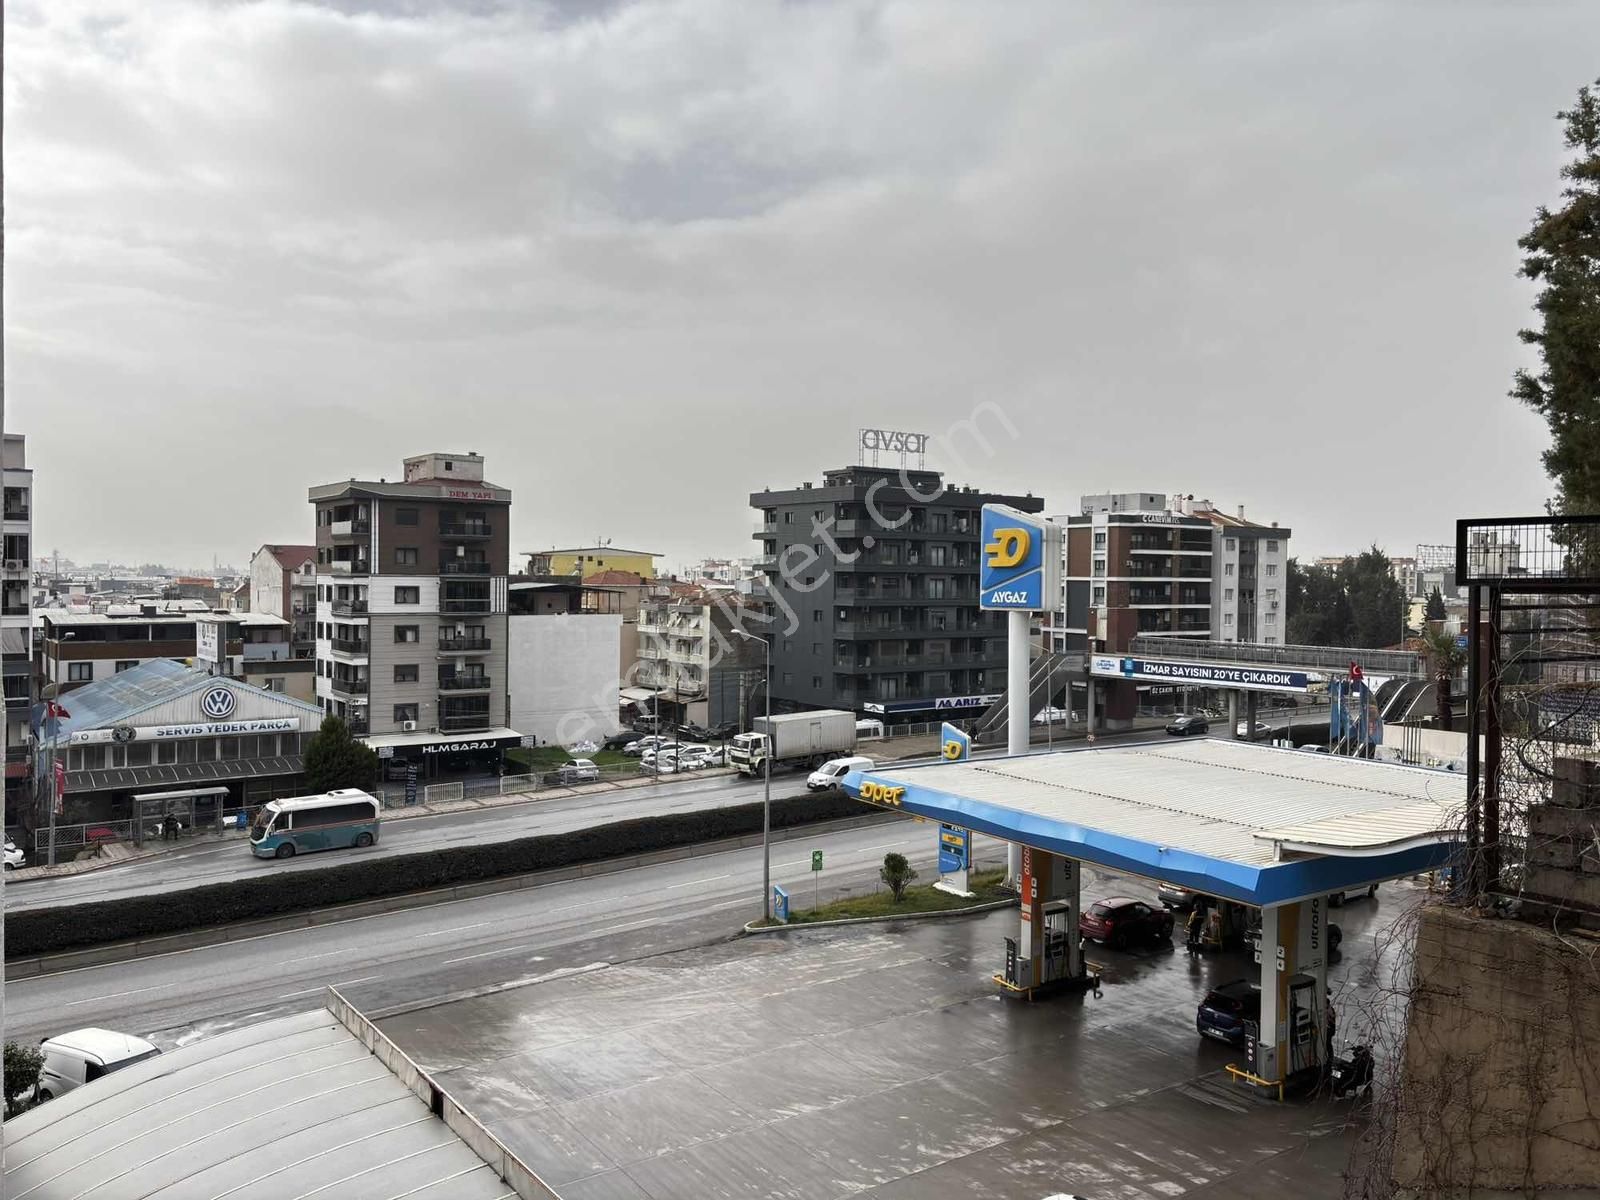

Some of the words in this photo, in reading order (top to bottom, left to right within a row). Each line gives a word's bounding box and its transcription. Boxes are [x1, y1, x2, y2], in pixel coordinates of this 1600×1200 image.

[991, 591, 1028, 603] AYGAZ
[1143, 662, 1170, 674] İZMAR
[1171, 666, 1212, 679] SAYISINI
[1213, 670, 1241, 680] 20'YE
[1241, 671, 1292, 685] ÇIKARDIK
[207, 722, 248, 734] YEDEK
[250, 719, 292, 731] PARÇA
[860, 781, 905, 805] opet
